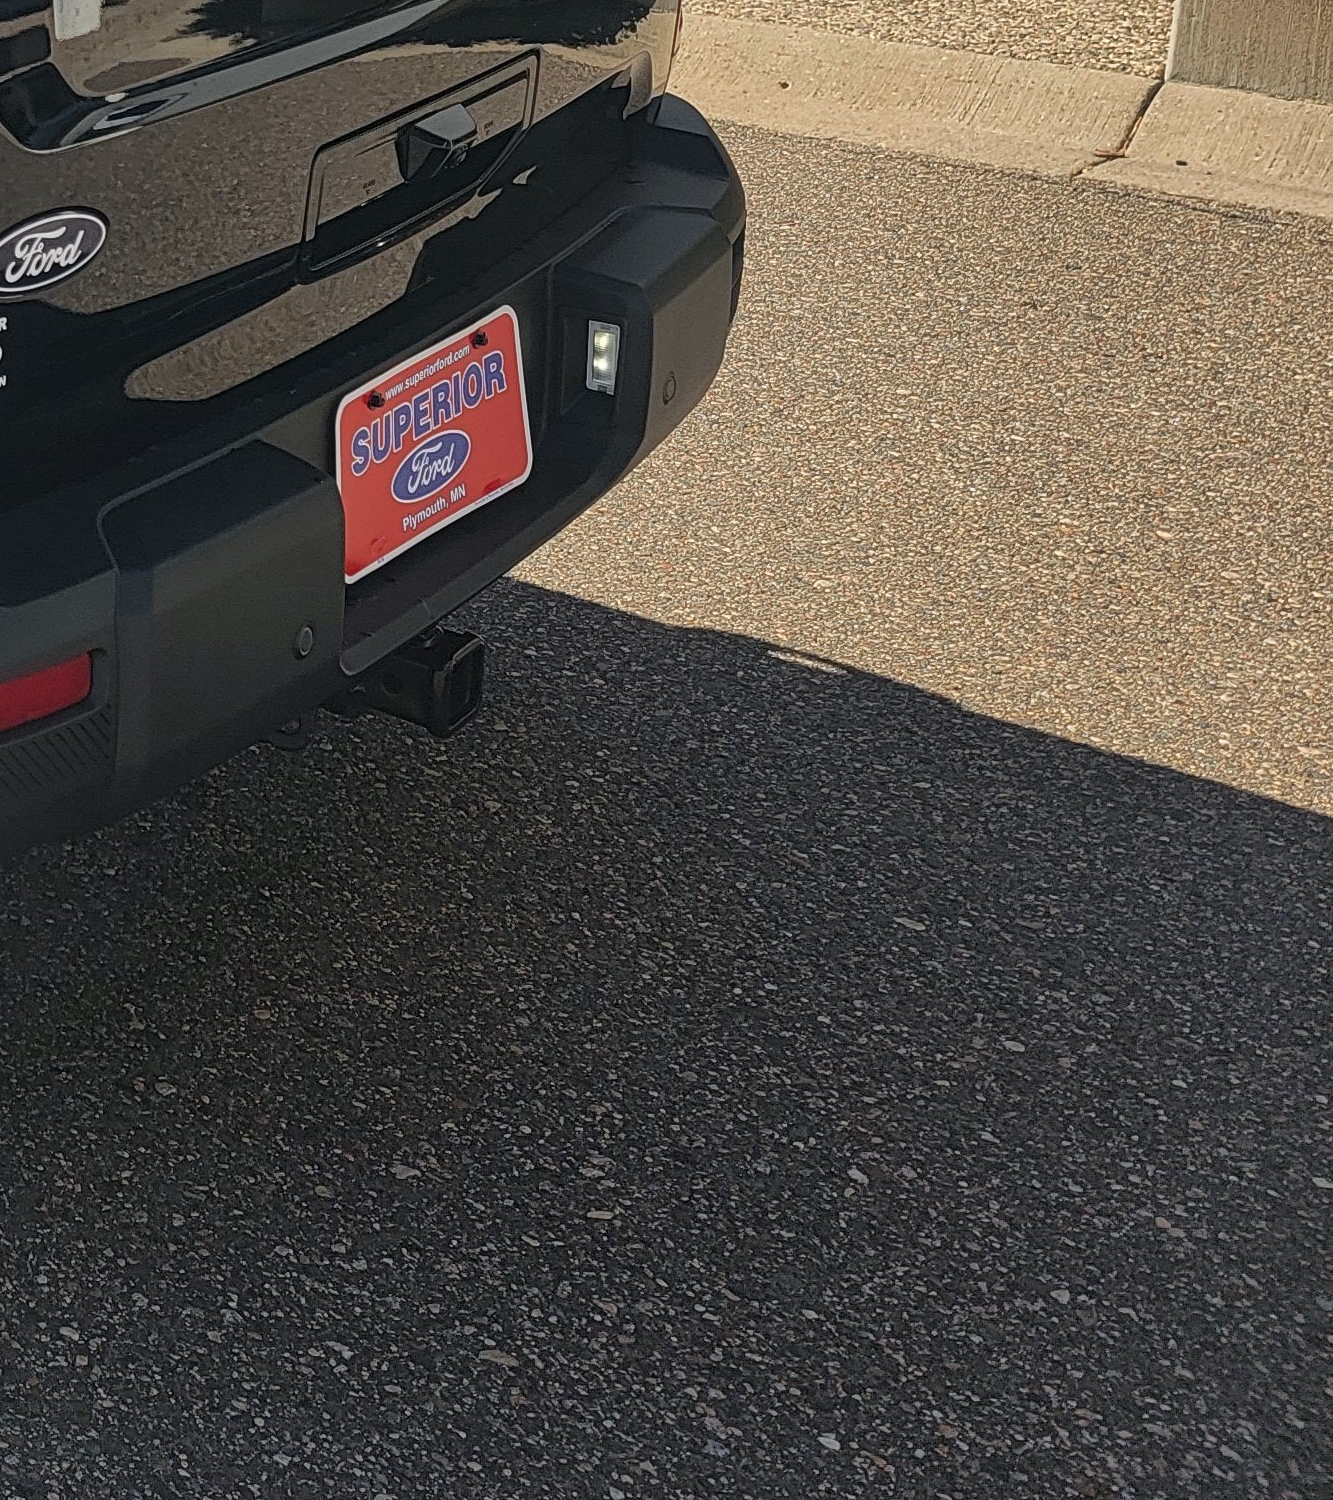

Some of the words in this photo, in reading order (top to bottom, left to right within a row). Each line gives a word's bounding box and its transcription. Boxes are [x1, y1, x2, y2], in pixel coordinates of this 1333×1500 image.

[4, 225, 85, 284] Ford
[384, 344, 471, 401] www.superiorford.com
[350, 350, 507, 477] SUPERIOR
[407, 441, 455, 495] Ford
[402, 495, 450, 533] Plymouth,
[449, 483, 467, 505] MN
